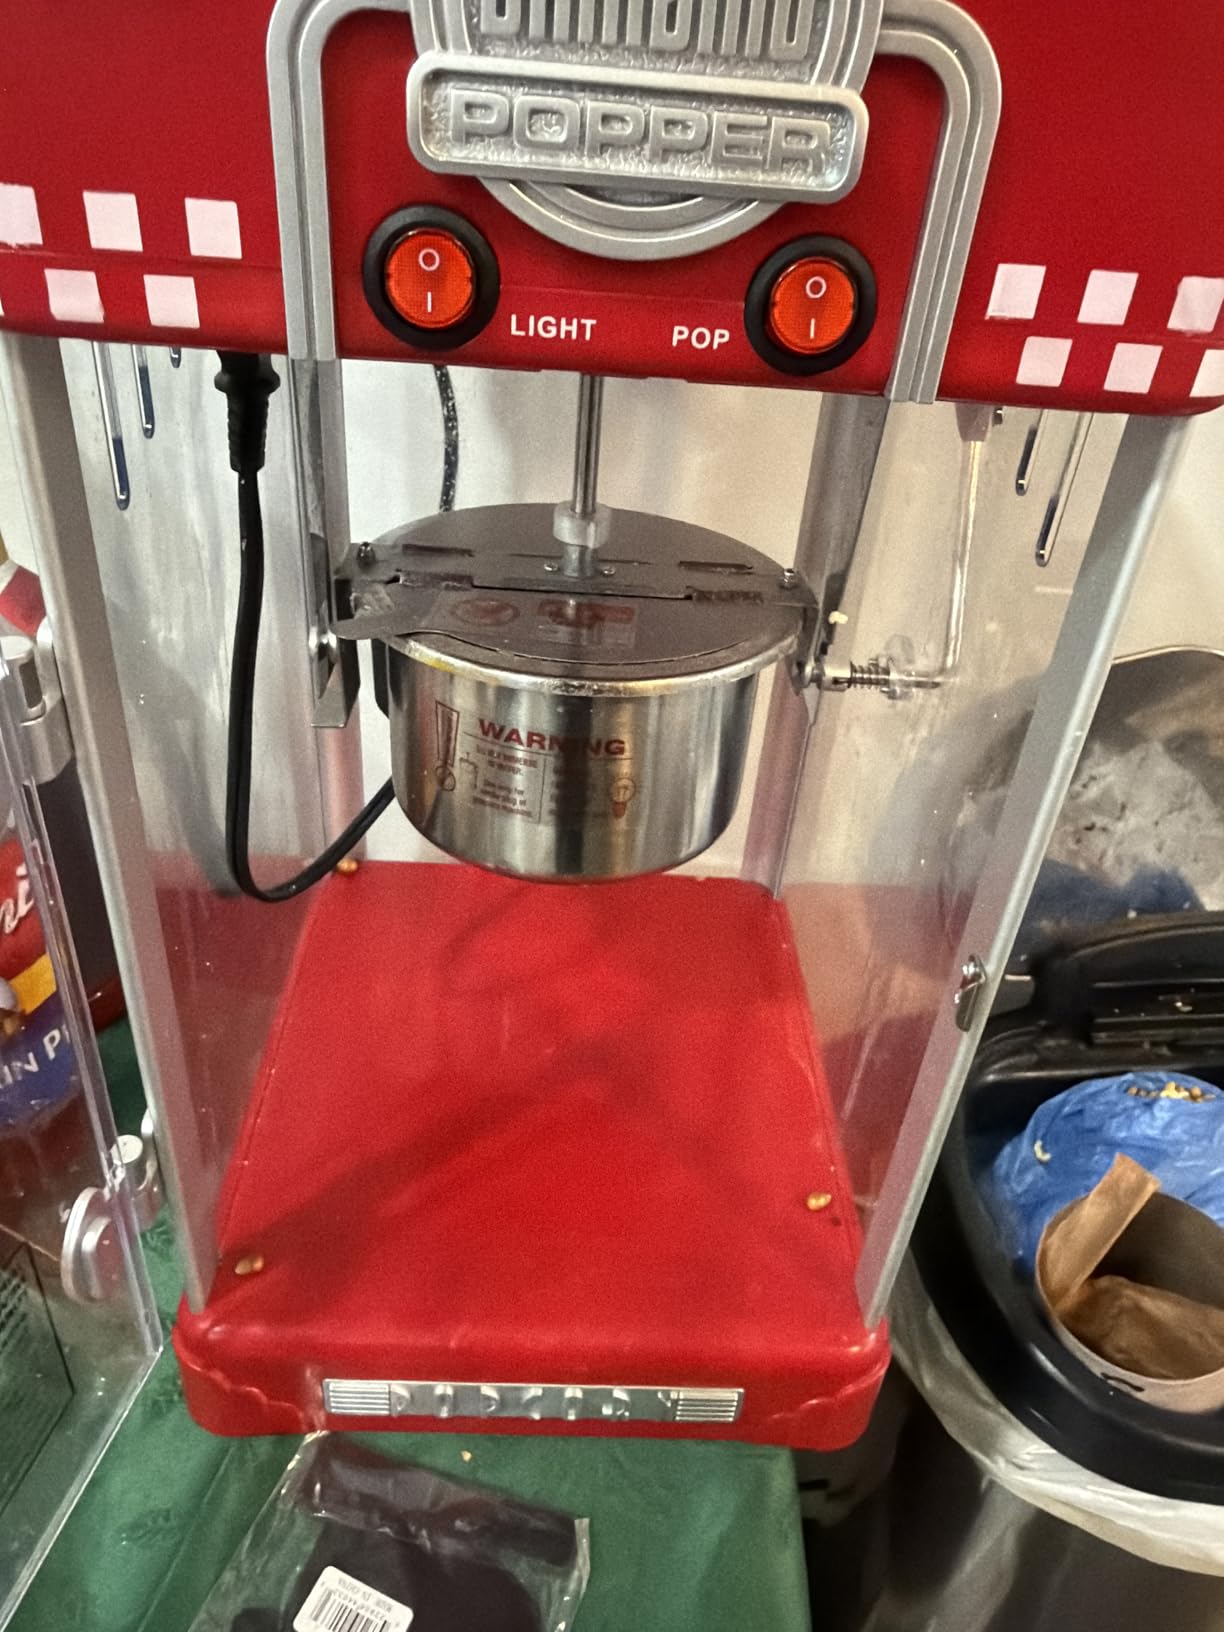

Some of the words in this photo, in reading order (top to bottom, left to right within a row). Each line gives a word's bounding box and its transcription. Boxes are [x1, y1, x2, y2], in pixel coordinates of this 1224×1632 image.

[450, 88, 832, 175] POPPER
[510, 313, 597, 341] LIGHT
[671, 325, 731, 350] POP
[478, 718, 626, 756] WARNING
